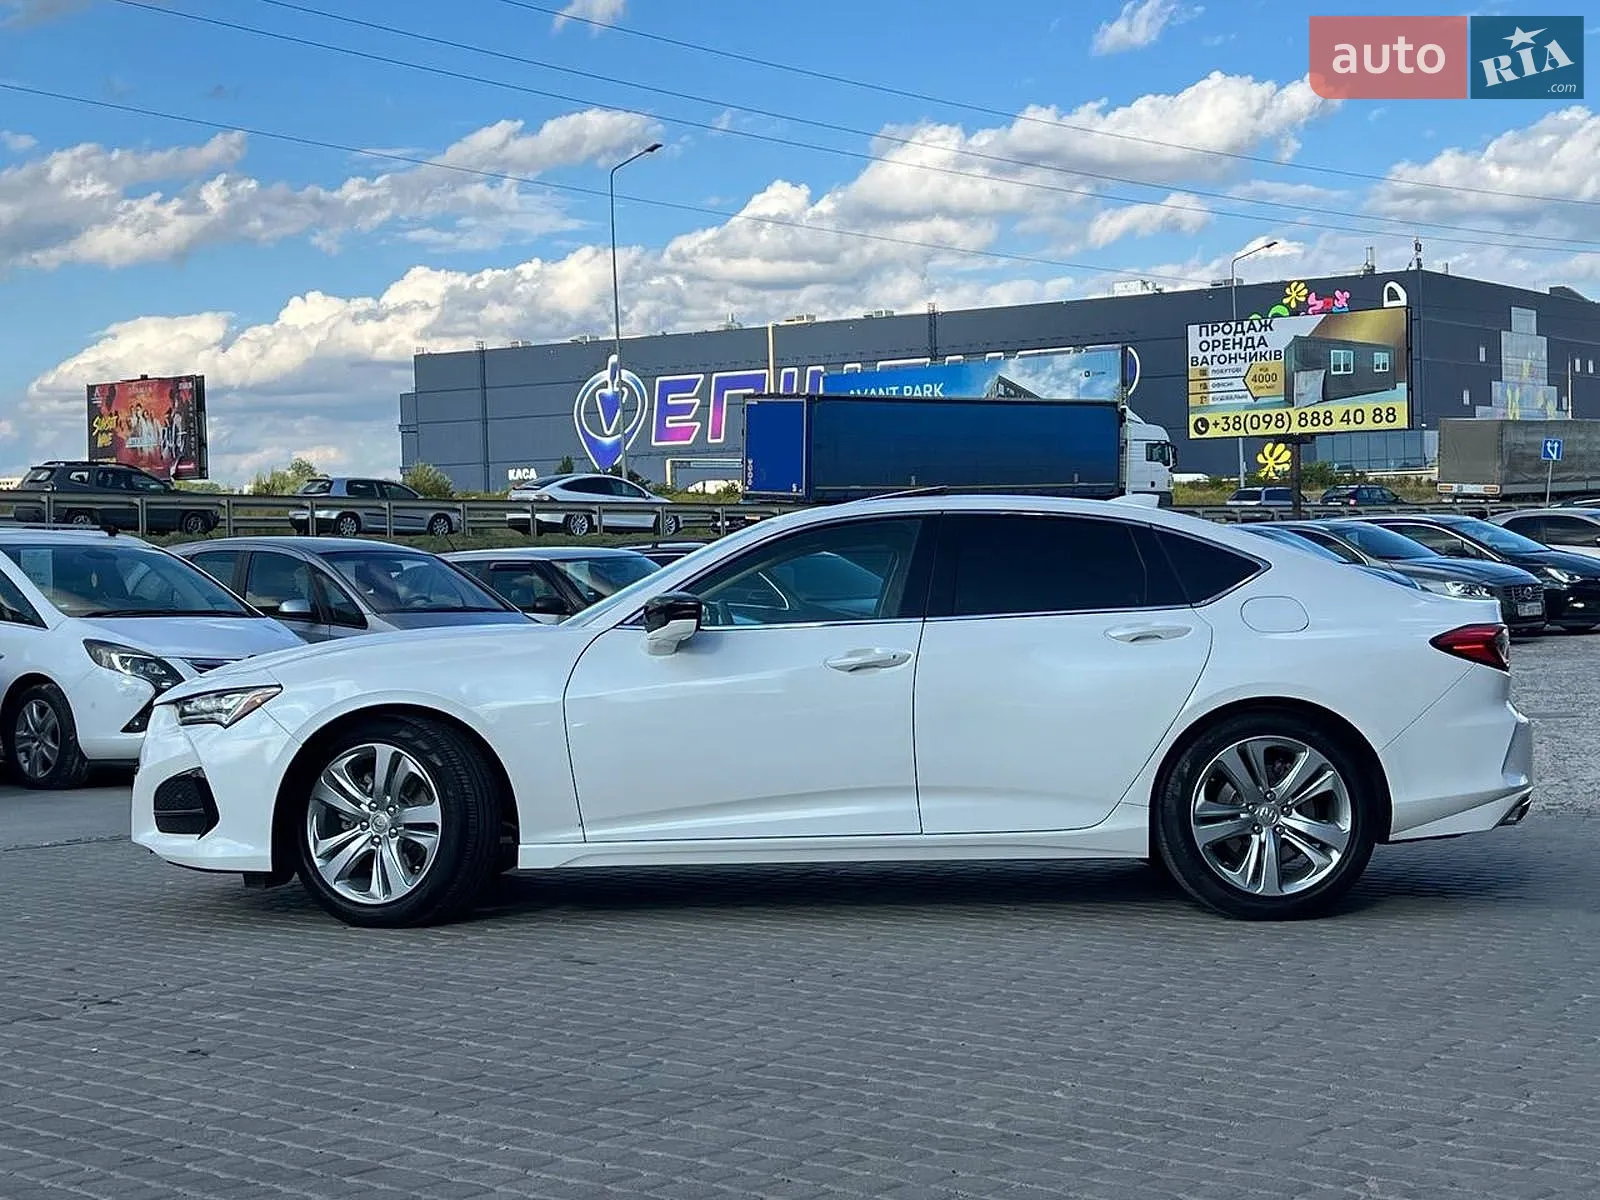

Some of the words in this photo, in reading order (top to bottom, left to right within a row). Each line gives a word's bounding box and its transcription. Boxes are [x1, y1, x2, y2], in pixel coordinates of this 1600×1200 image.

[1199, 319, 1274, 337] ПРОДАЖ
[1199, 335, 1269, 352] ОРЕНДА
[1190, 349, 1283, 367] ВАГОНЧИКІВ
[1251, 372, 1278, 384] 4000
[903, 382, 944, 397] PARK
[1212, 411, 1292, 434] +38(098)
[1297, 410, 1334, 428] 888
[1339, 408, 1365, 425] 40
[1371, 407, 1398, 424] 88
[508, 467, 538, 481] КАСА
